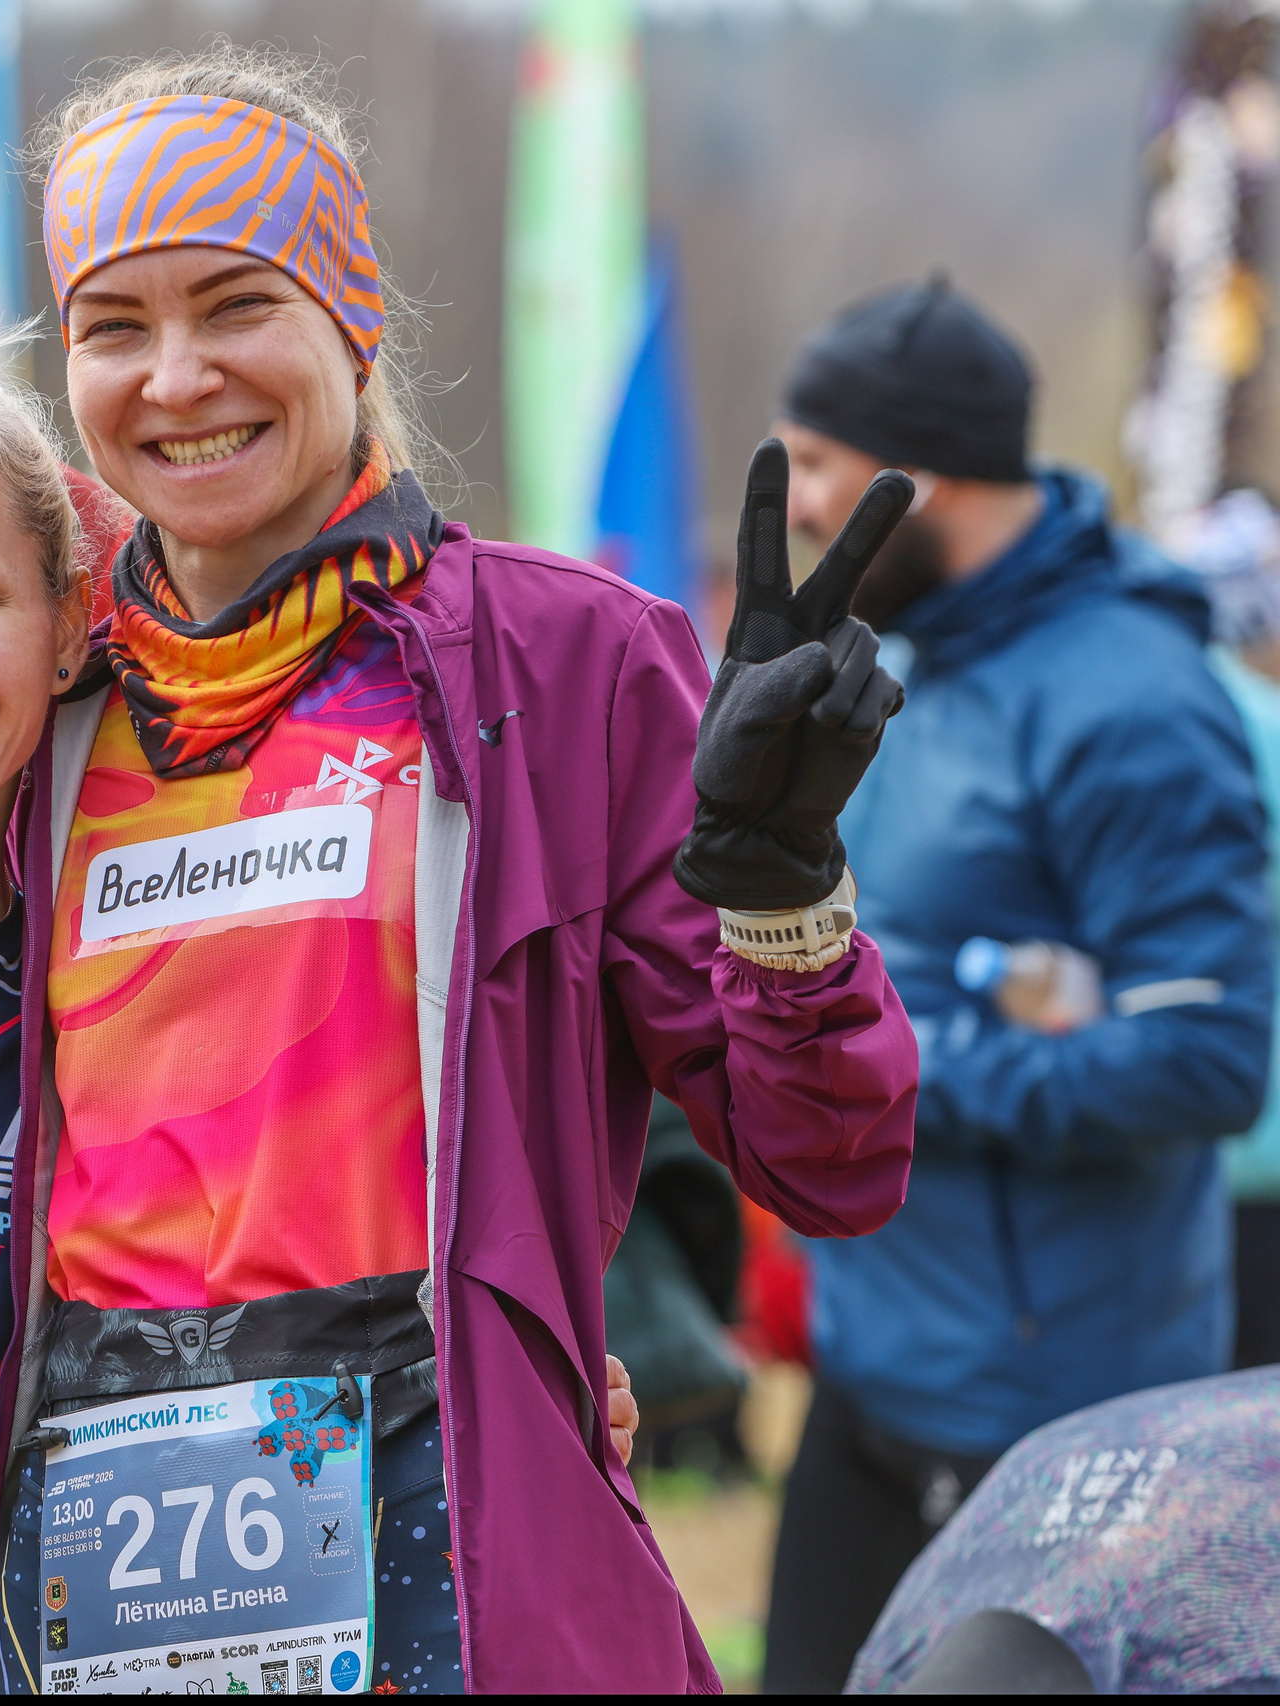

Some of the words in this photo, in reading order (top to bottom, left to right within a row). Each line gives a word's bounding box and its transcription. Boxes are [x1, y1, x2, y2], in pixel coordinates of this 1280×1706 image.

[180, 1327, 200, 1348] G
[185, 1402, 228, 1424] ЛЕС
[67, 1473, 94, 1485] DREAM
[95, 1470, 114, 1484] 2026
[70, 1481, 91, 1491] TRAIL
[308, 1491, 344, 1502] ПИТАНИЕ
[52, 1497, 94, 1526] 13,00
[105, 1477, 284, 1591] 276
[115, 1596, 208, 1625] Лёткина
[212, 1585, 288, 1611] Елена
[266, 1636, 326, 1652] ALPINDUSTRIA
[182, 1648, 215, 1662] ТАФГАЙ
[220, 1644, 259, 1660] SCOR
[51, 1667, 77, 1681] EASY
[54, 1681, 75, 1693] POP
